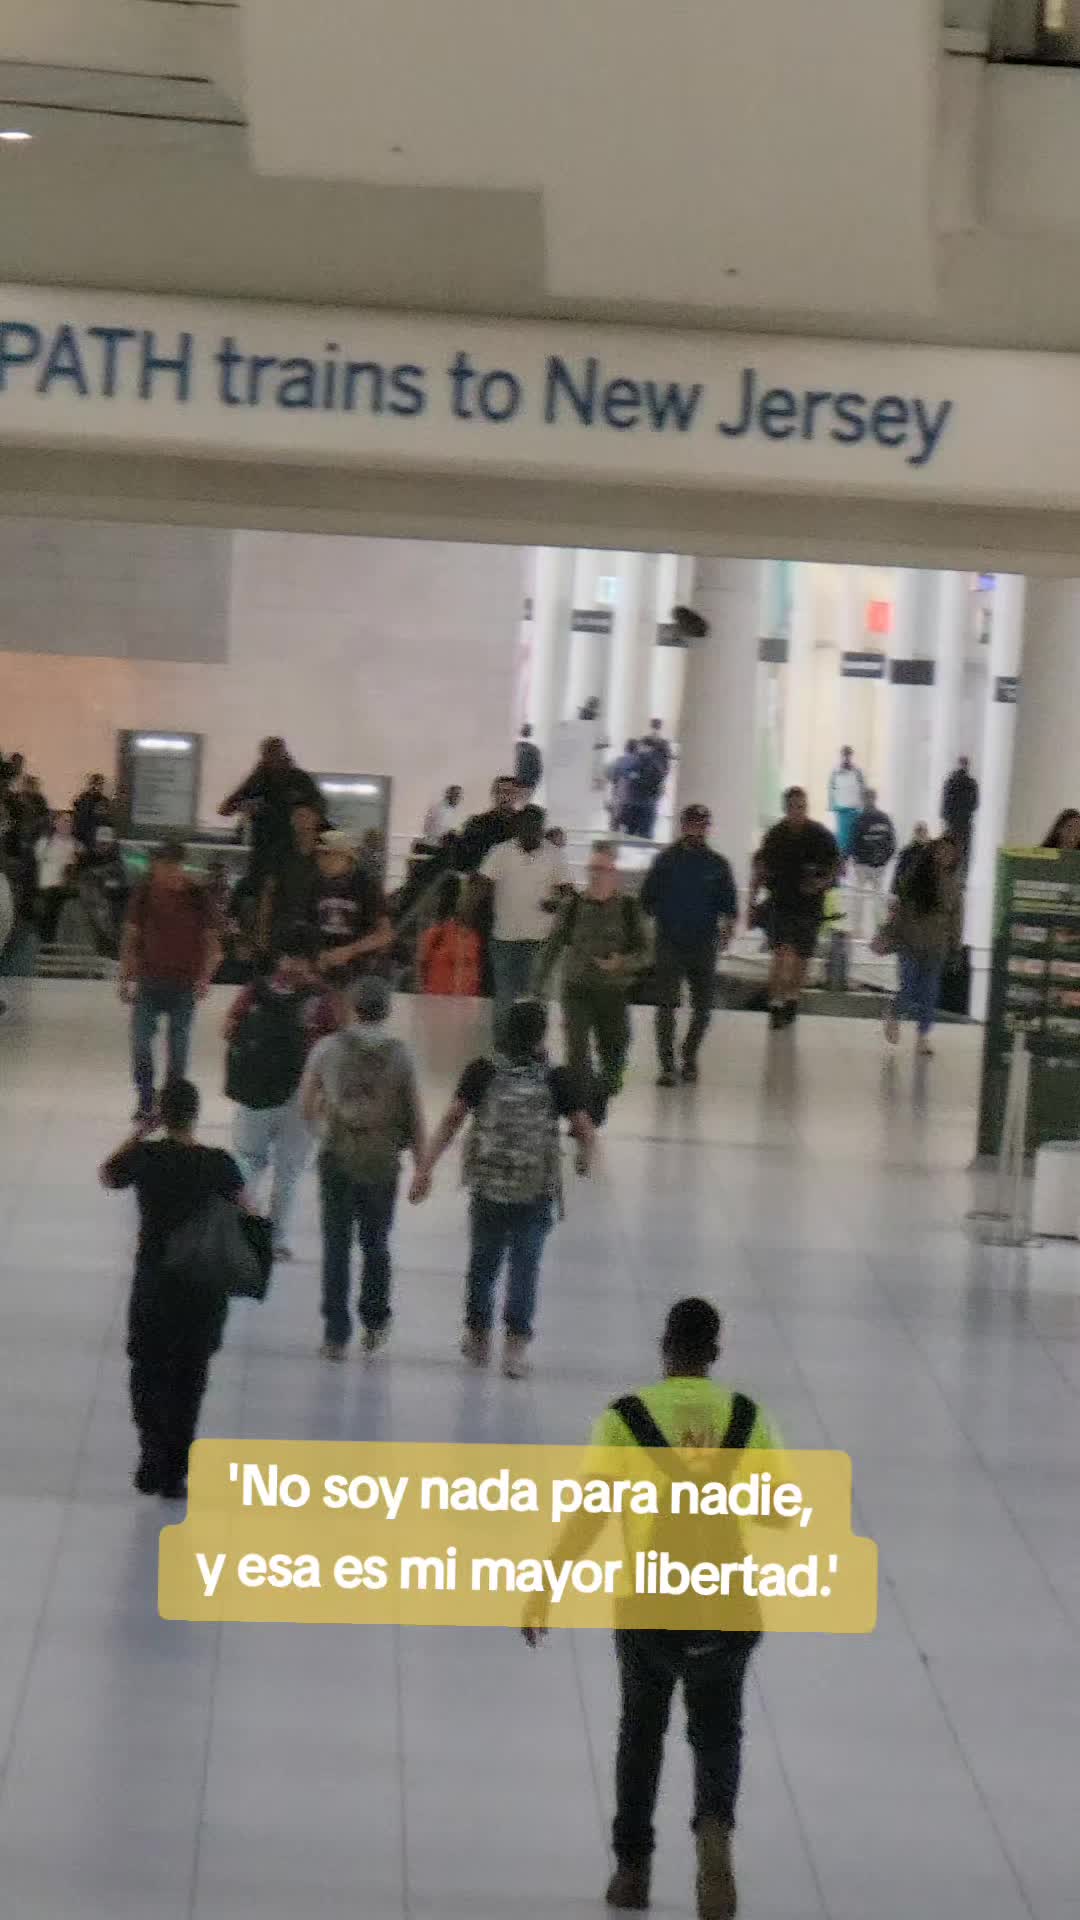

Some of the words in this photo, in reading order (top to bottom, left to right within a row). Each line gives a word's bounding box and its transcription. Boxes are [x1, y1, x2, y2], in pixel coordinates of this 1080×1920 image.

[0, 320, 194, 401] PATH
[216, 336, 426, 417] trains
[447, 351, 523, 423] to
[543, 354, 704, 433] New
[717, 368, 953, 467] Jersey
